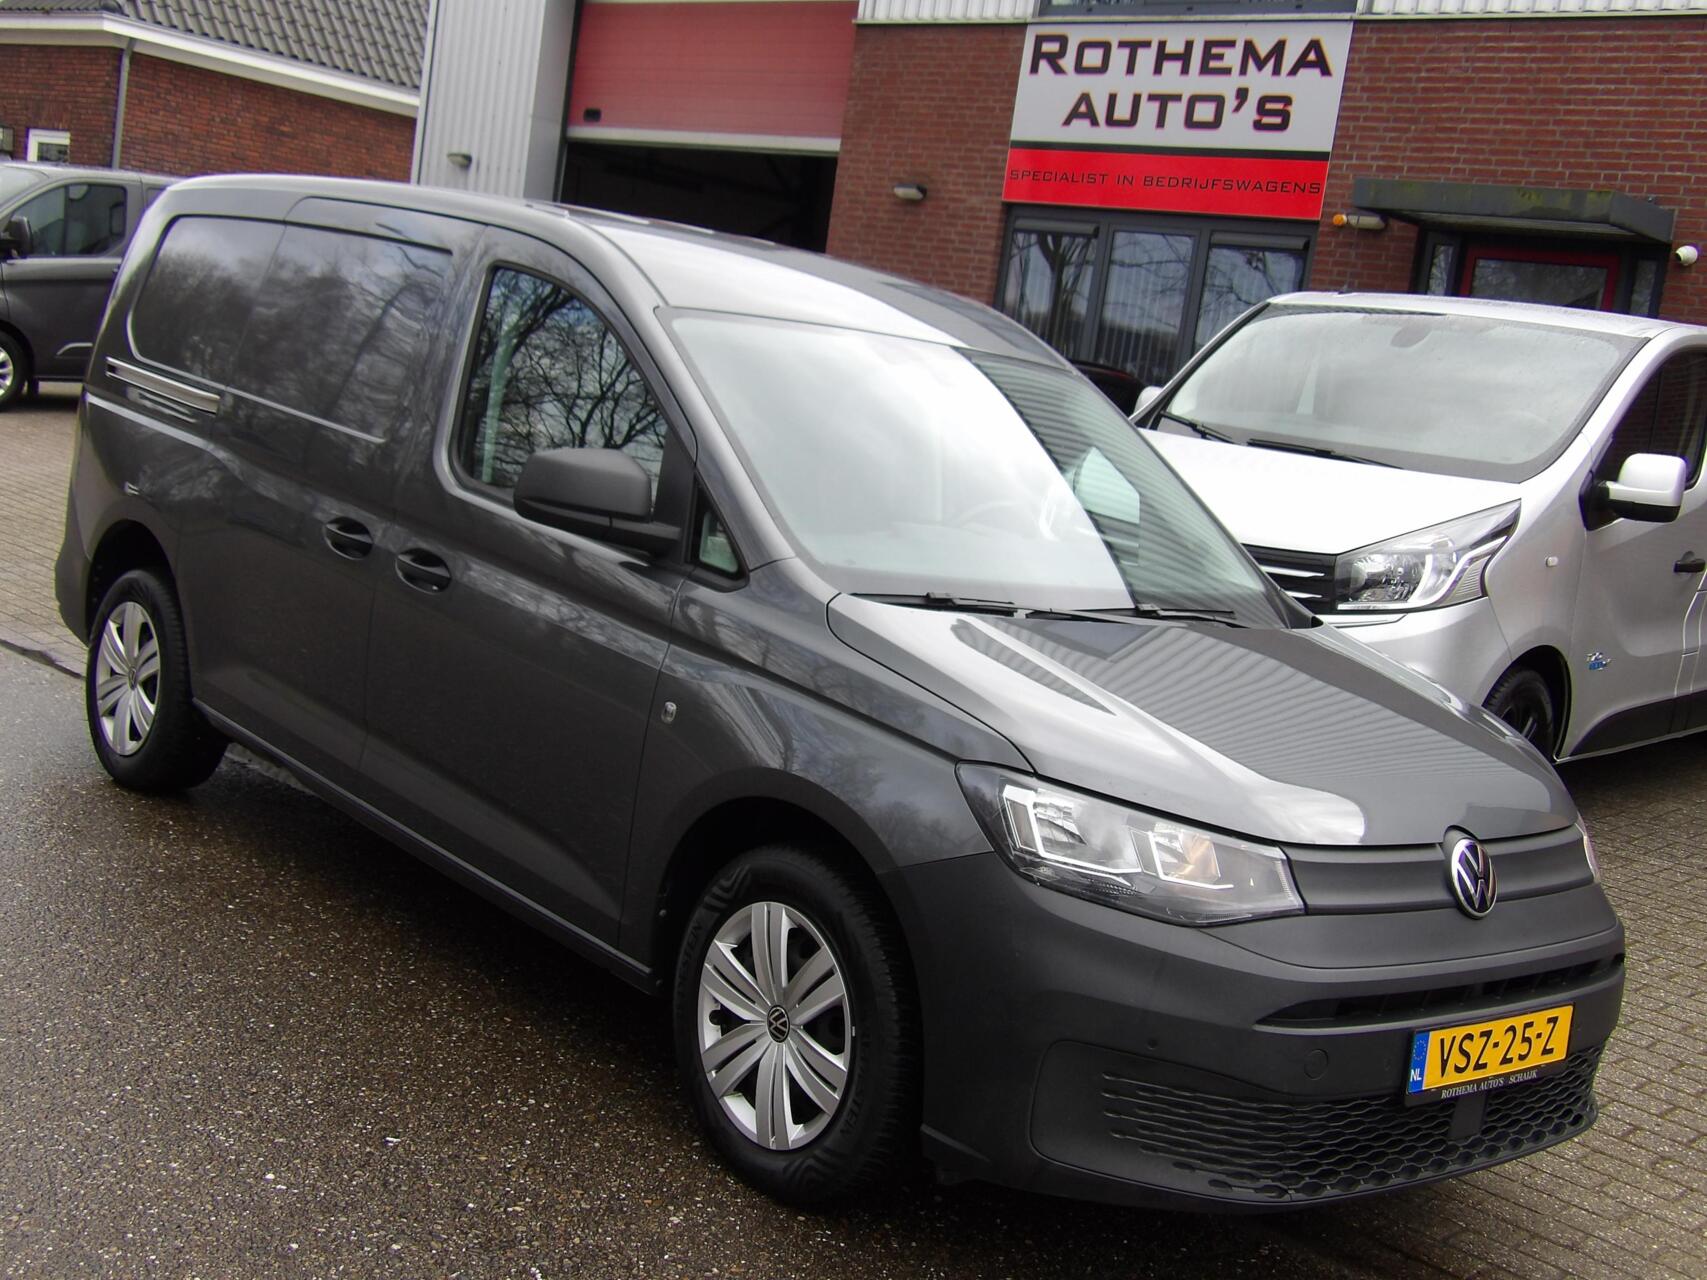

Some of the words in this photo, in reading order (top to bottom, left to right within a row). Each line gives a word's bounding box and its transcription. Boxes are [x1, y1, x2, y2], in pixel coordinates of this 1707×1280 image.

[1029, 33, 1333, 77] ROTHEMA
[1061, 87, 1293, 133] AUTO'S
[1009, 168, 1109, 186] SPECIALIST
[1116, 173, 1134, 187] IN
[1142, 175, 1322, 195] BEDRIJFSWAGENS
[1439, 1015, 1559, 1079] VSZ-25-Z
[1410, 1068, 1422, 1082] NL
[1441, 1083, 1477, 1099] ROTHEMA
[1478, 1077, 1504, 1091] AUTO'S
